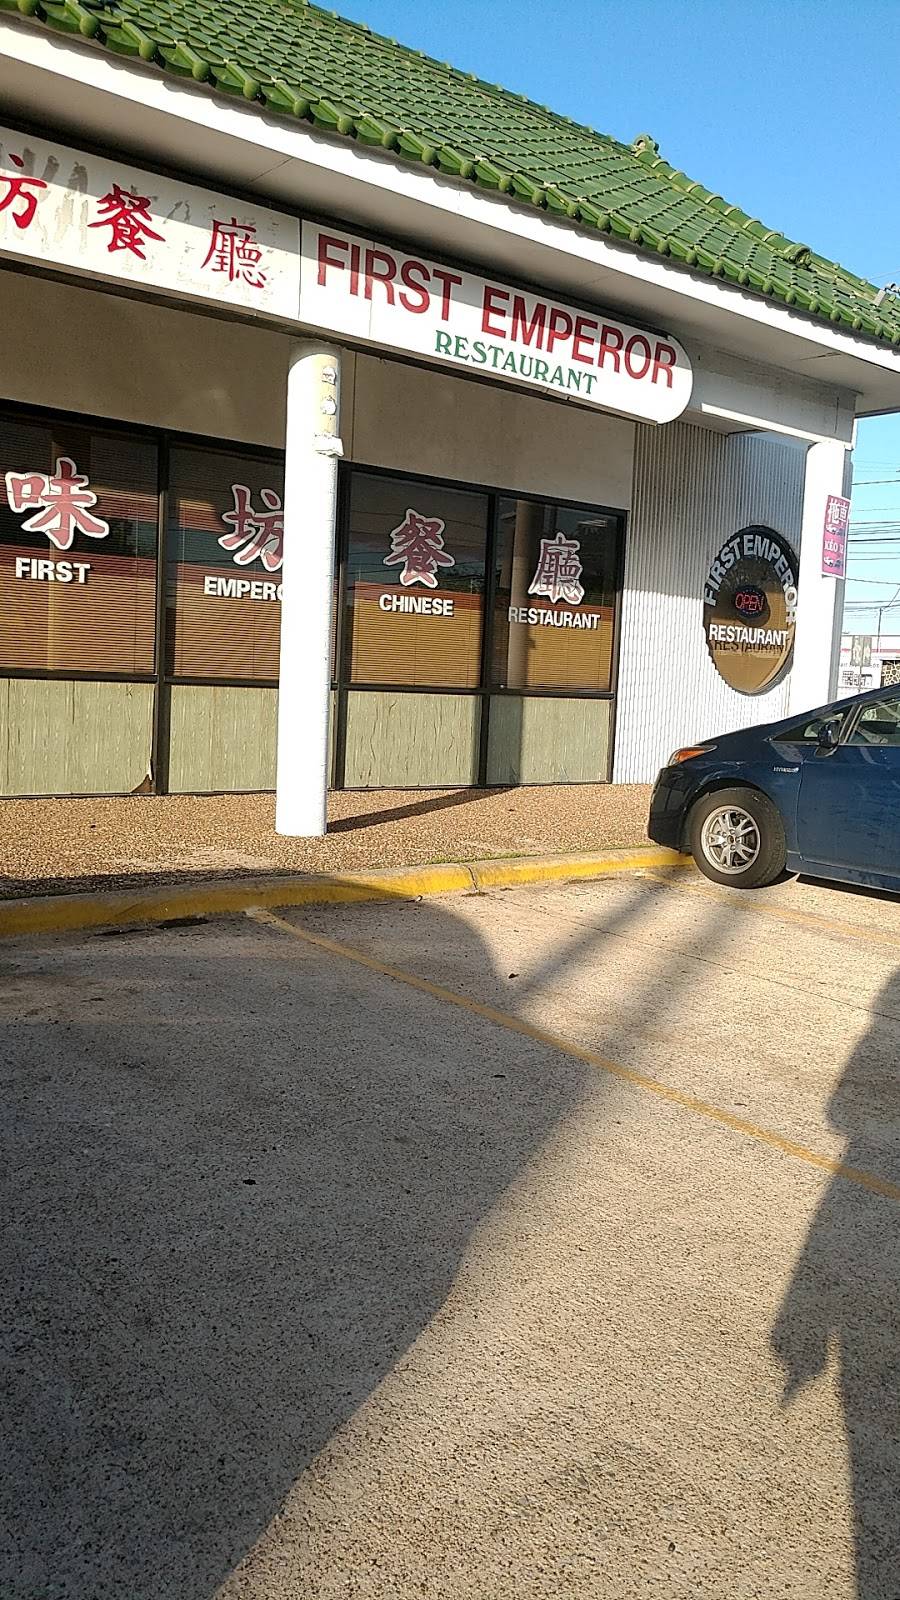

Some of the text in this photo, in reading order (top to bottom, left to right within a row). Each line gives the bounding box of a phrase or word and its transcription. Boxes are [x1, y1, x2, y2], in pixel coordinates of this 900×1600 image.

[317, 233, 677, 389] FIRST EMPEROR
[434, 329, 598, 395] RESTAURANT
[15, 557, 601, 630] FIRST EMPER CHINESE RESTAURANT
[704, 534, 798, 625] FIRST EMPEROR
[735, 593, 764, 611] OPEN
[709, 624, 789, 646] RESTAURANT
